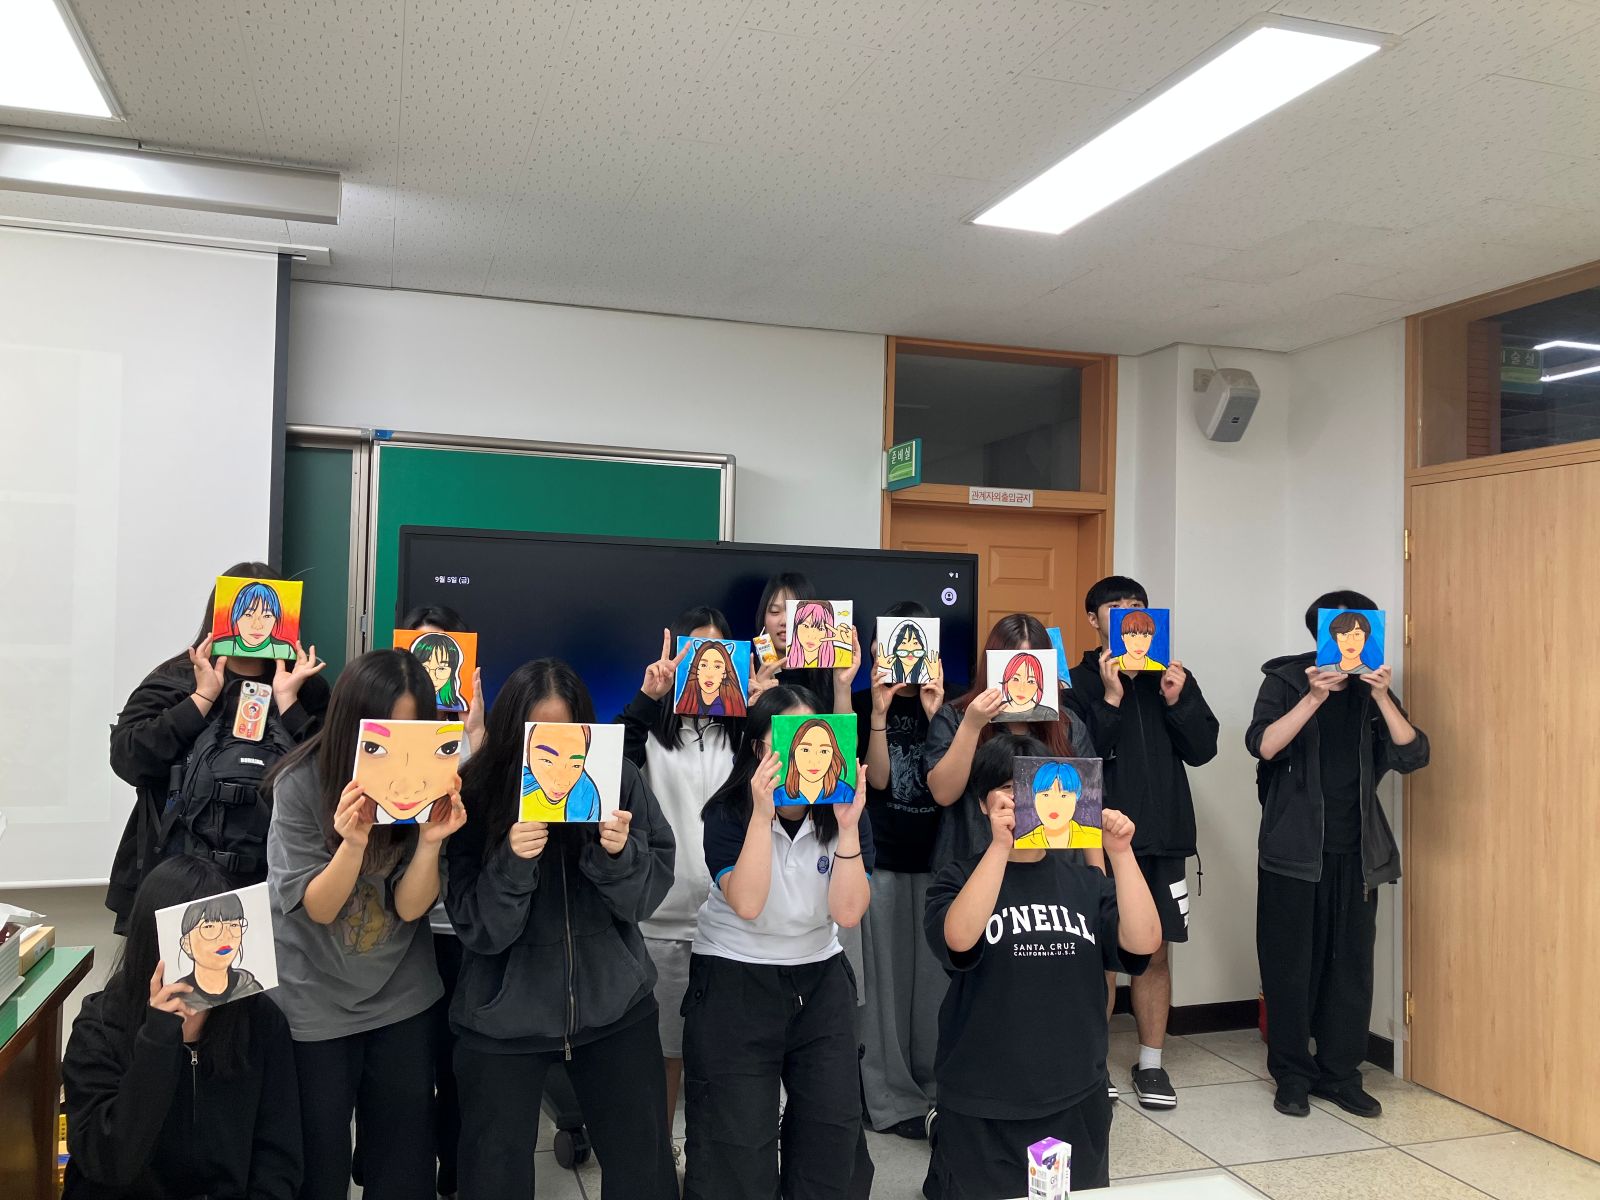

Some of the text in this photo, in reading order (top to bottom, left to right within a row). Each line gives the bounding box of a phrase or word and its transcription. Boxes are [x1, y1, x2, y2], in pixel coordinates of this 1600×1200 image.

[891, 446, 911, 465] 준비실
[434, 575, 470, 585] 9월 5일 (금)
[985, 904, 1096, 945] O'NEILL
[1013, 942, 1076, 951] SANTA CRUZ
